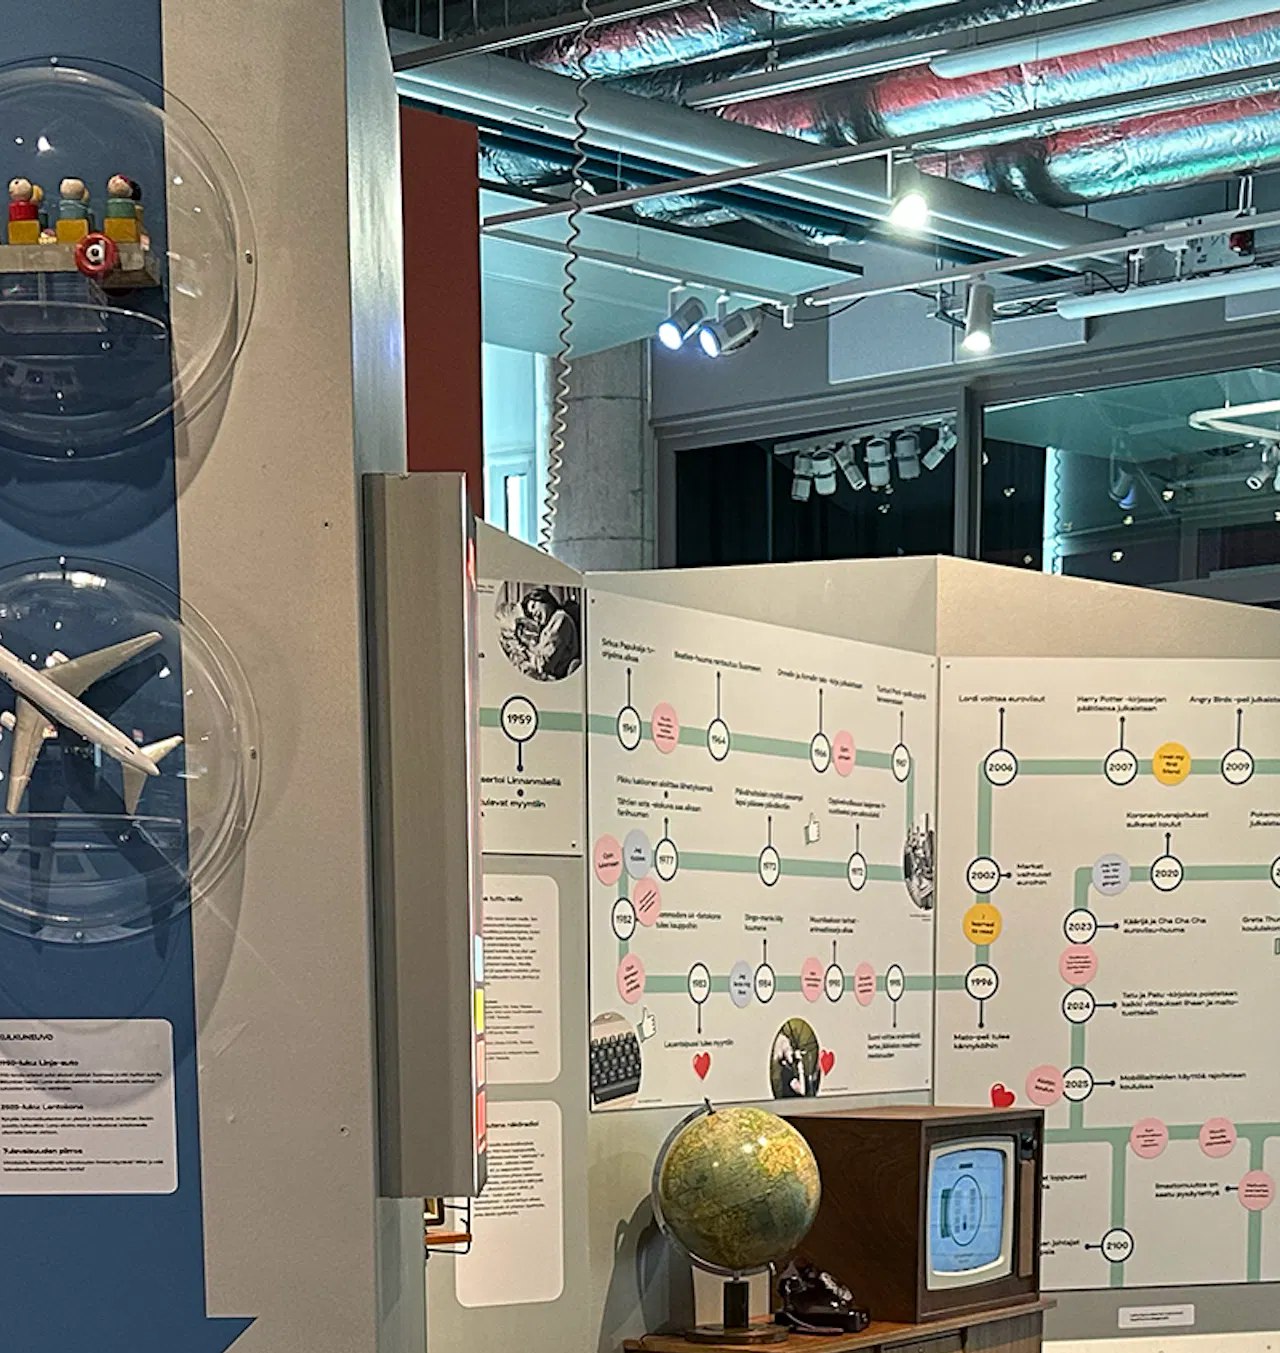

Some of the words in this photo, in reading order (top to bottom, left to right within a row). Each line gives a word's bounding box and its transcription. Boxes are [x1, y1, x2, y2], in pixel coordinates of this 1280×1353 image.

[1077, 696, 1098, 704] Harry
[1189, 696, 1211, 704] Angry
[507, 714, 531, 725] 1959
[988, 763, 1013, 772] 2006
[1109, 763, 1133, 771] 2007
[1225, 762, 1250, 771] 2009
[507, 776, 561, 786] Linnanmäellä
[1155, 870, 1179, 878] 2020
[1069, 923, 1092, 931] 2023
[1067, 1002, 1090, 1010] 2024
[1065, 1080, 1088, 1088] 2025
[1106, 1242, 1129, 1250] 2100
